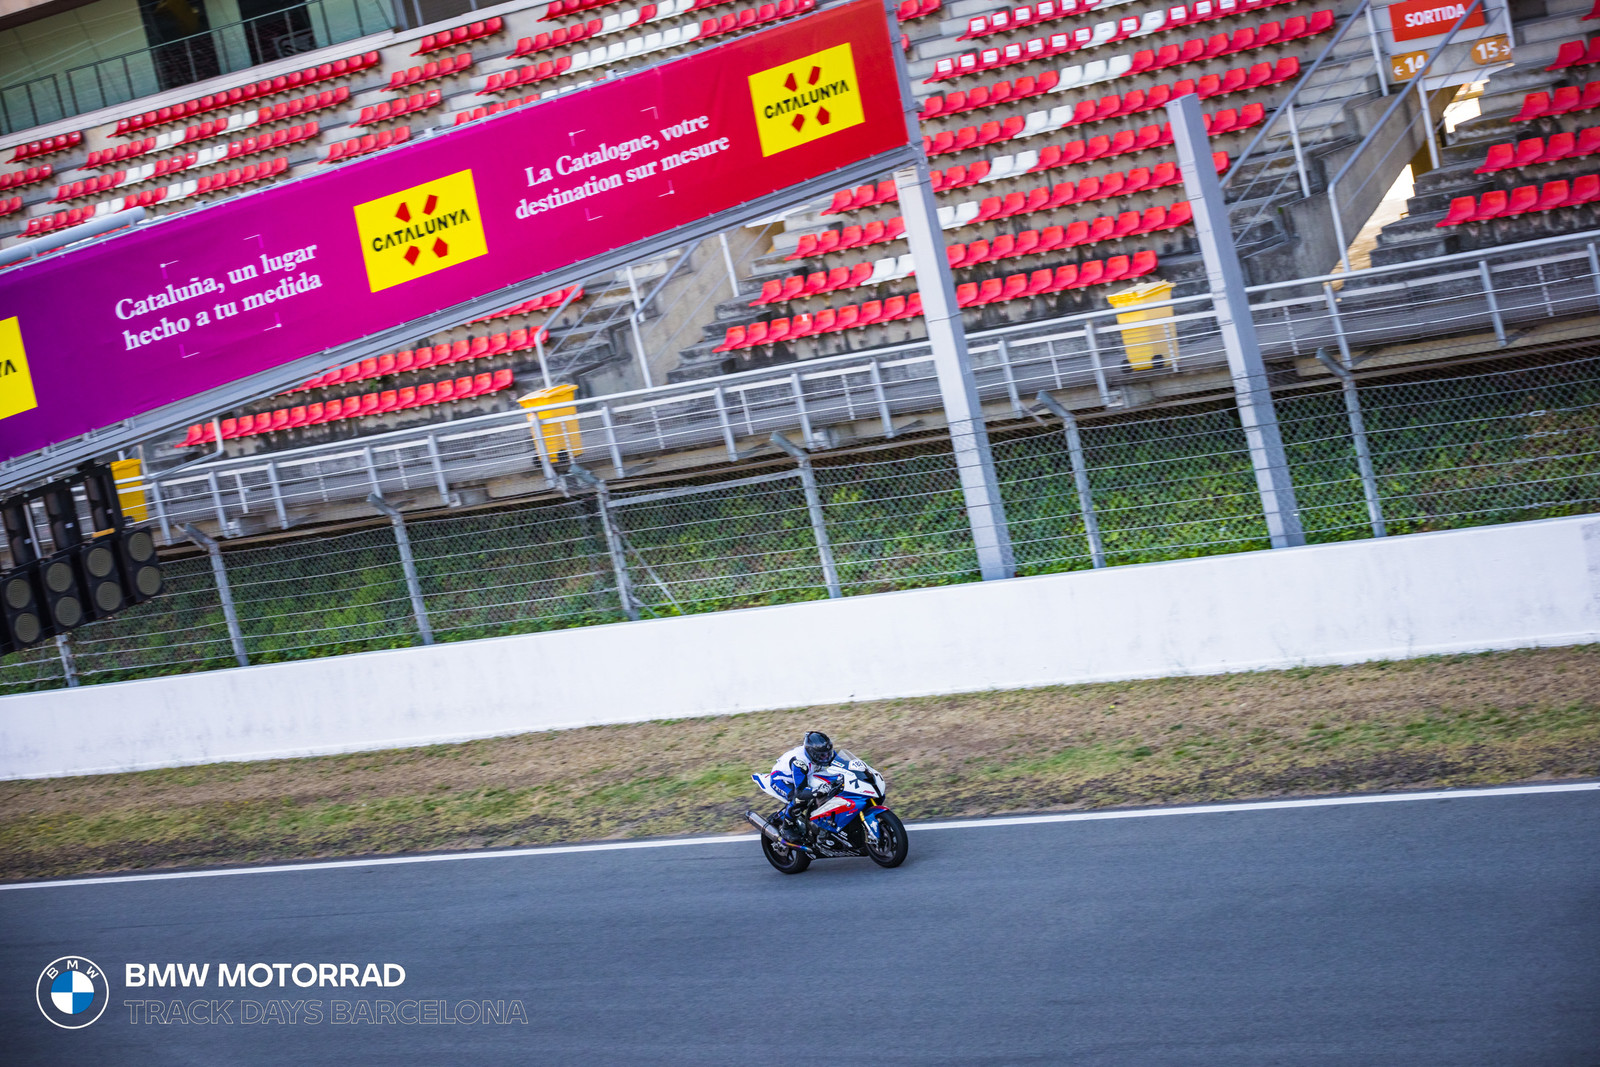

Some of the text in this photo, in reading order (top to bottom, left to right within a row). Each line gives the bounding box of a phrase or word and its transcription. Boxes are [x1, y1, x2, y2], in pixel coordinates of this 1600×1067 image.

[1404, 3, 1467, 28] SORTIDA
[1404, 54, 1426, 73] 14
[1476, 41, 1499, 60] 15
[764, 79, 850, 119] CATALUNYA
[524, 114, 710, 187] La Catalogne, votre
[514, 136, 730, 220] destination sur mesure
[372, 208, 471, 252] CATALUNYA
[114, 244, 318, 321] Cataluña, un lugar
[121, 271, 324, 351] hecho a tu medida
